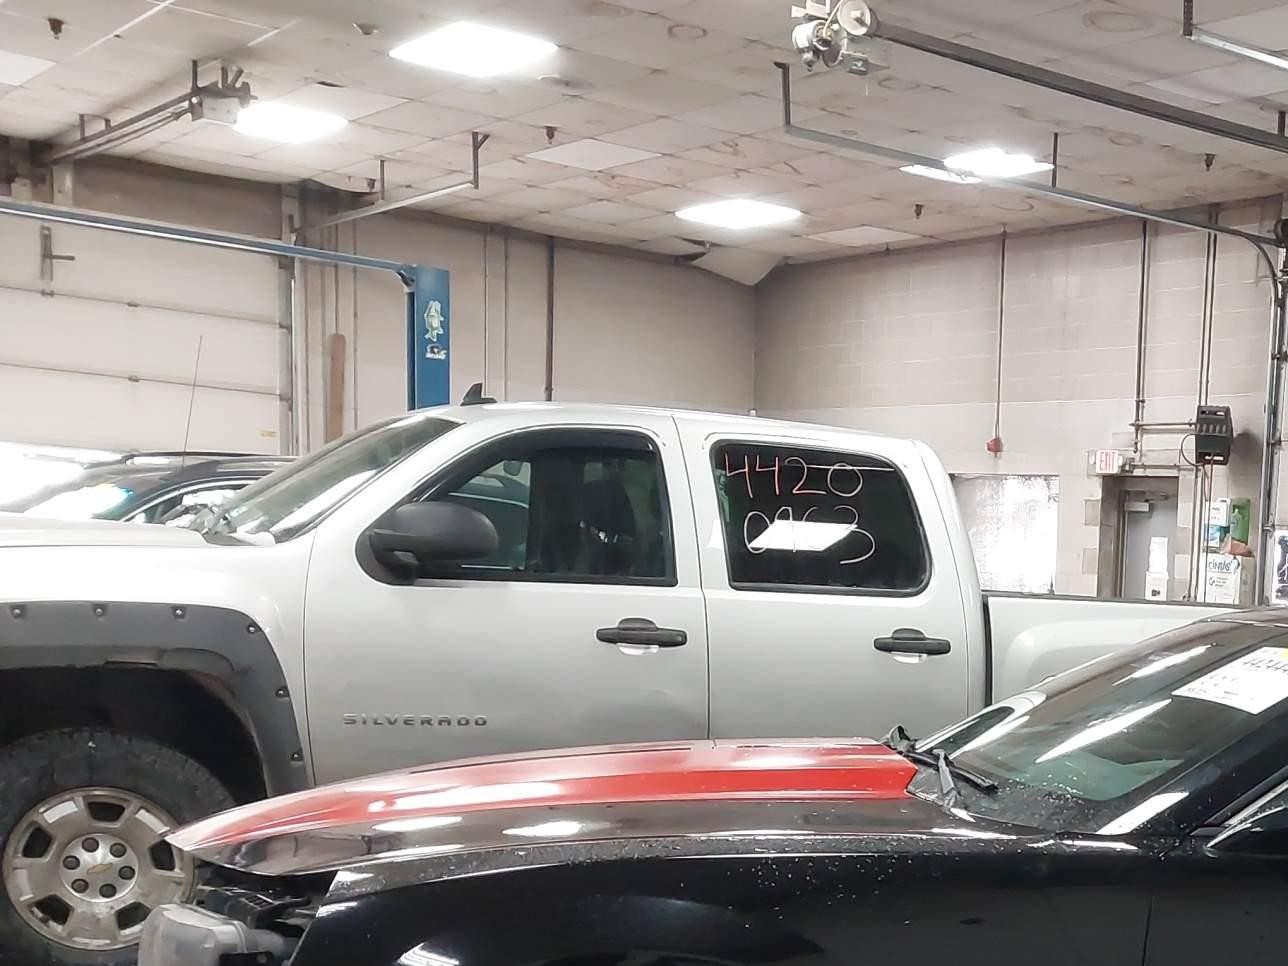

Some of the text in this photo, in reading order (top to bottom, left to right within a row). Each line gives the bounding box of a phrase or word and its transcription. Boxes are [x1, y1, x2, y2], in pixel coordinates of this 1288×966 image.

[1099, 451, 1117, 473] EXIT
[724, 452, 863, 499] 4420
[343, 713, 488, 727] SILVERADO
